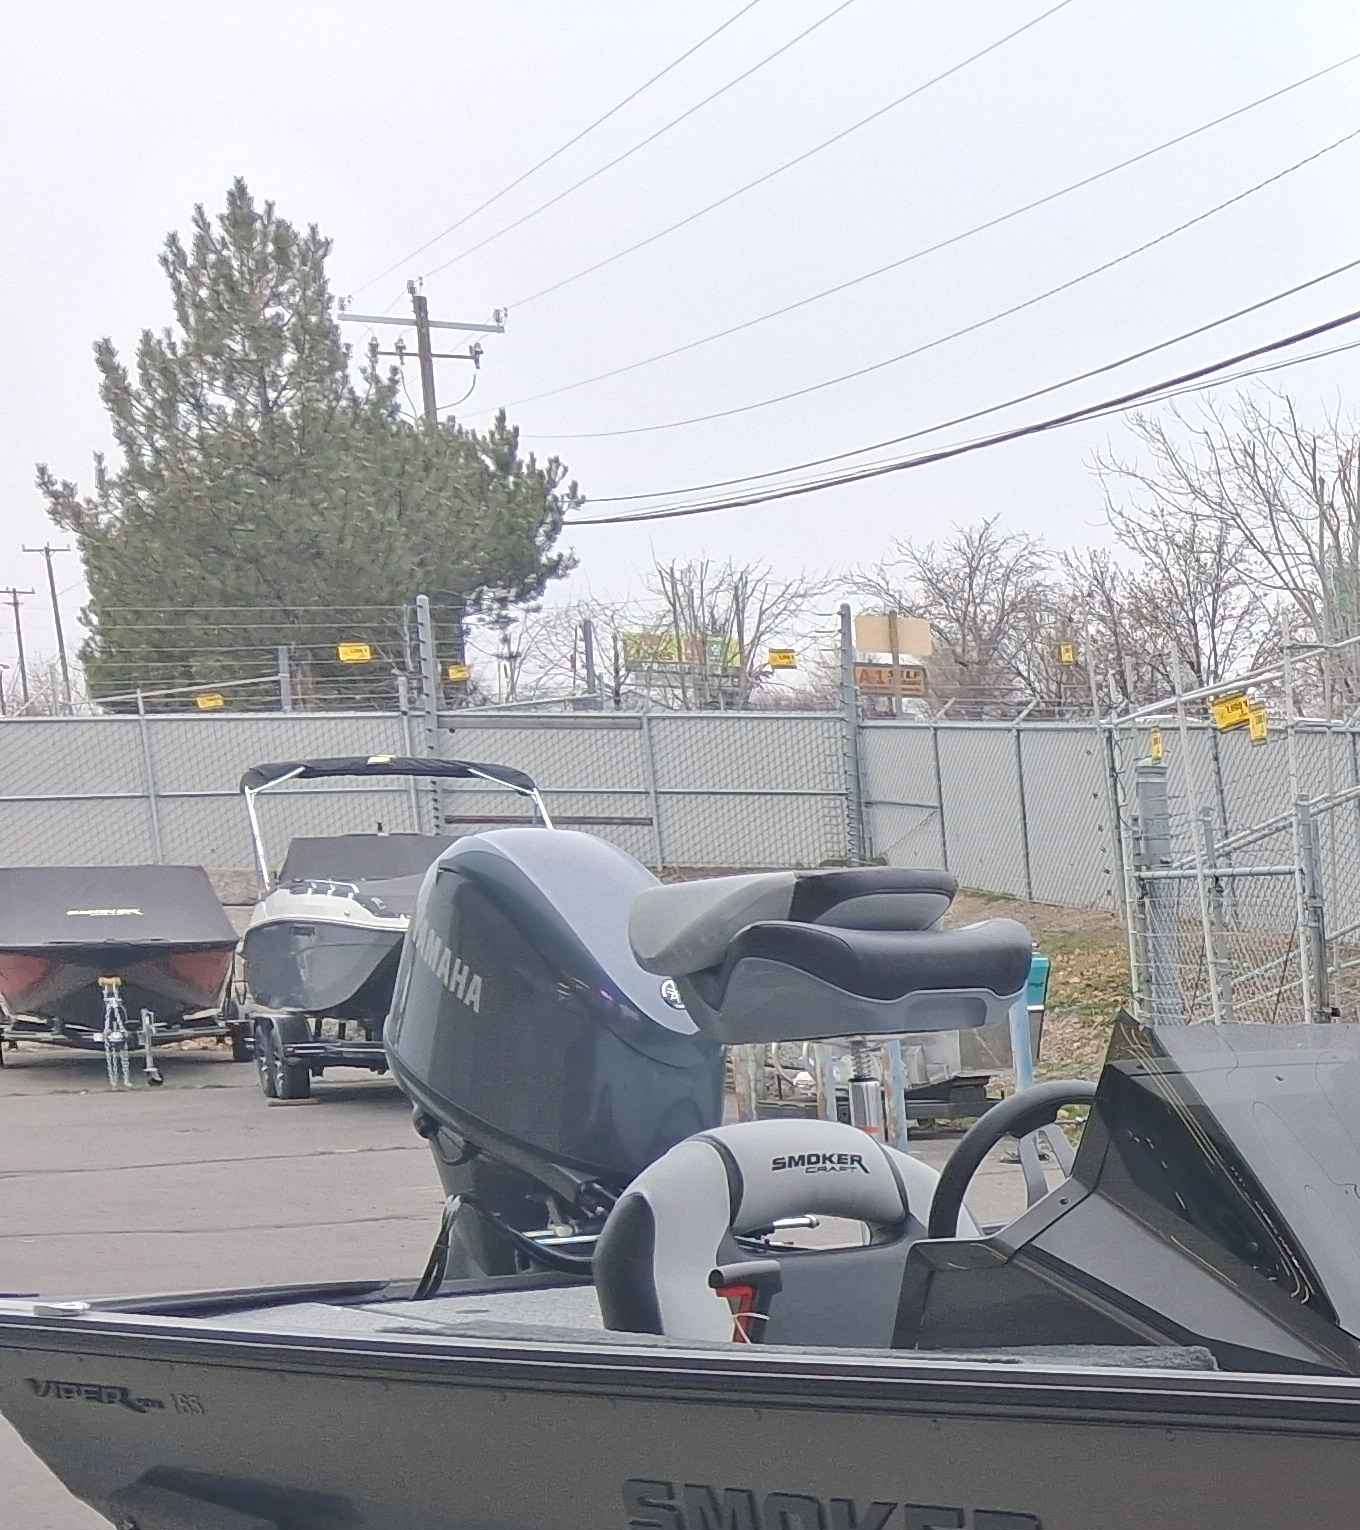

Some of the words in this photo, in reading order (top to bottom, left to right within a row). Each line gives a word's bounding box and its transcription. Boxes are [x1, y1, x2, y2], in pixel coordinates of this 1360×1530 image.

[771, 1152, 870, 1175] SMOKER
[805, 1166, 859, 1174] CRAFT
[24, 1377, 147, 1414] VIPER
